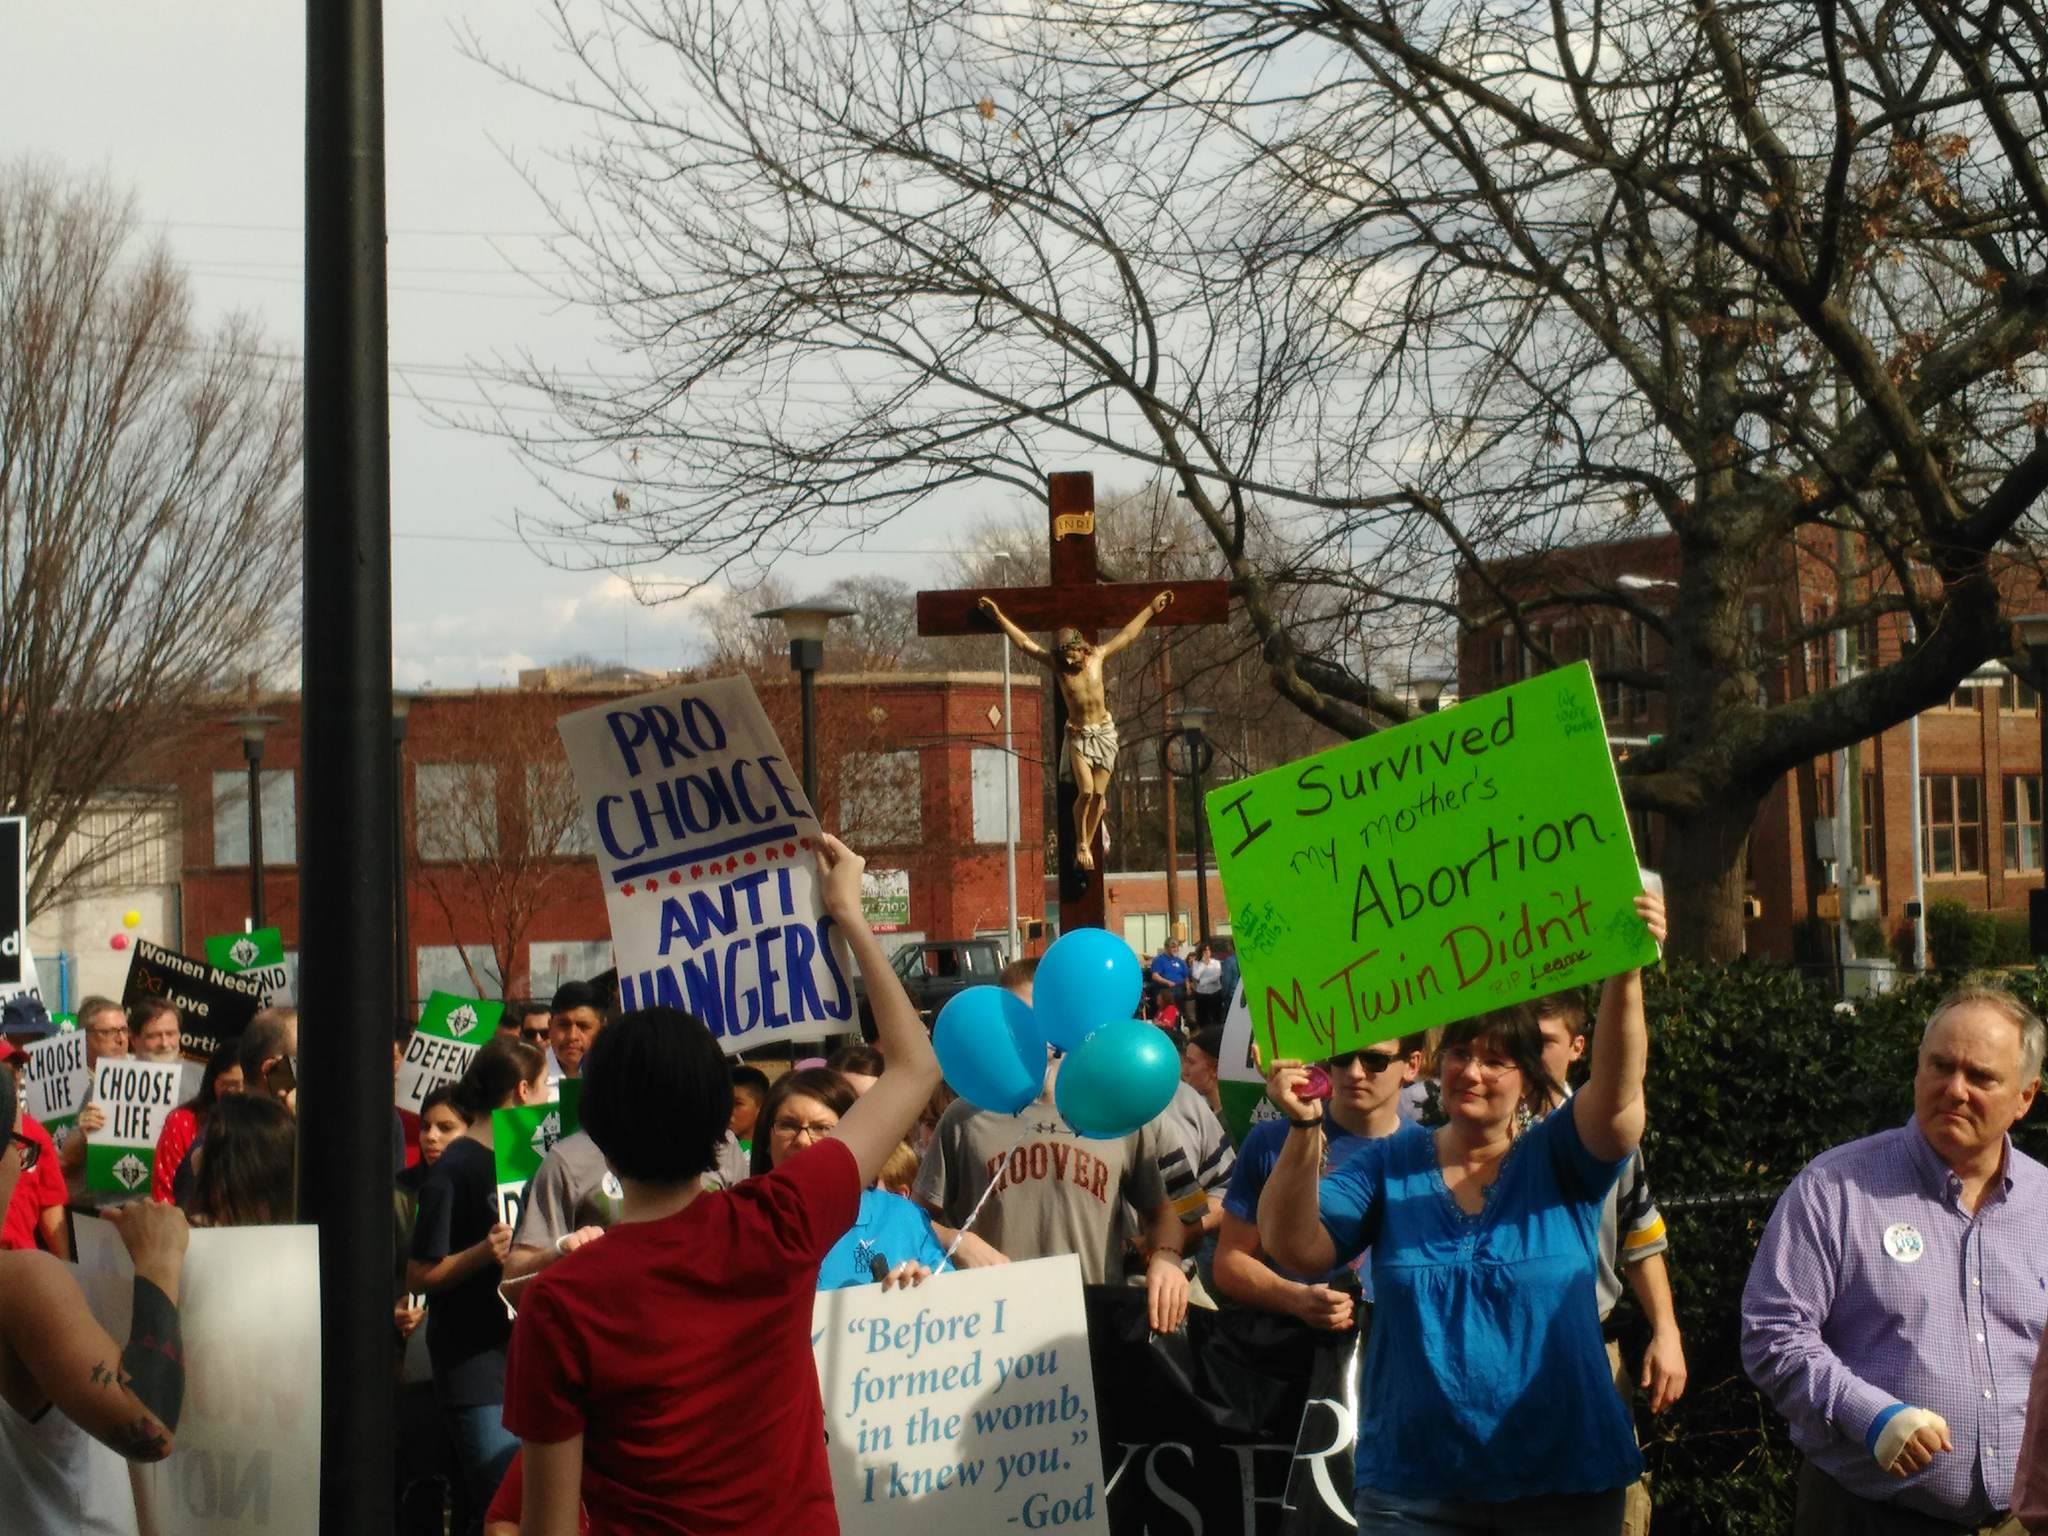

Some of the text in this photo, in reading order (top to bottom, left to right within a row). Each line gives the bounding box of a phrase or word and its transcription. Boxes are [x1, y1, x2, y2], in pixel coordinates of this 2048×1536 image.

[606, 697, 727, 778] PRO
[1221, 696, 1514, 858] I Survived
[596, 756, 813, 859] CHOICE
[1290, 838, 1338, 883] my
[658, 868, 795, 955] ANTI
[140, 941, 260, 997] Women Need
[406, 1036, 474, 1076] DEFEN
[44, 1076, 73, 1112] LIFE
[100, 1066, 174, 1106] CHOOSE
[114, 1104, 151, 1139] LIFE
[848, 1299, 1008, 1359] “Before I
[846, 1349, 1058, 1418] formed you
[857, 1384, 1089, 1455] in the womb,
[863, 1467, 877, 1504] I
[889, 1457, 984, 1500] knew
[1007, 1482, 1096, 1530] -God
